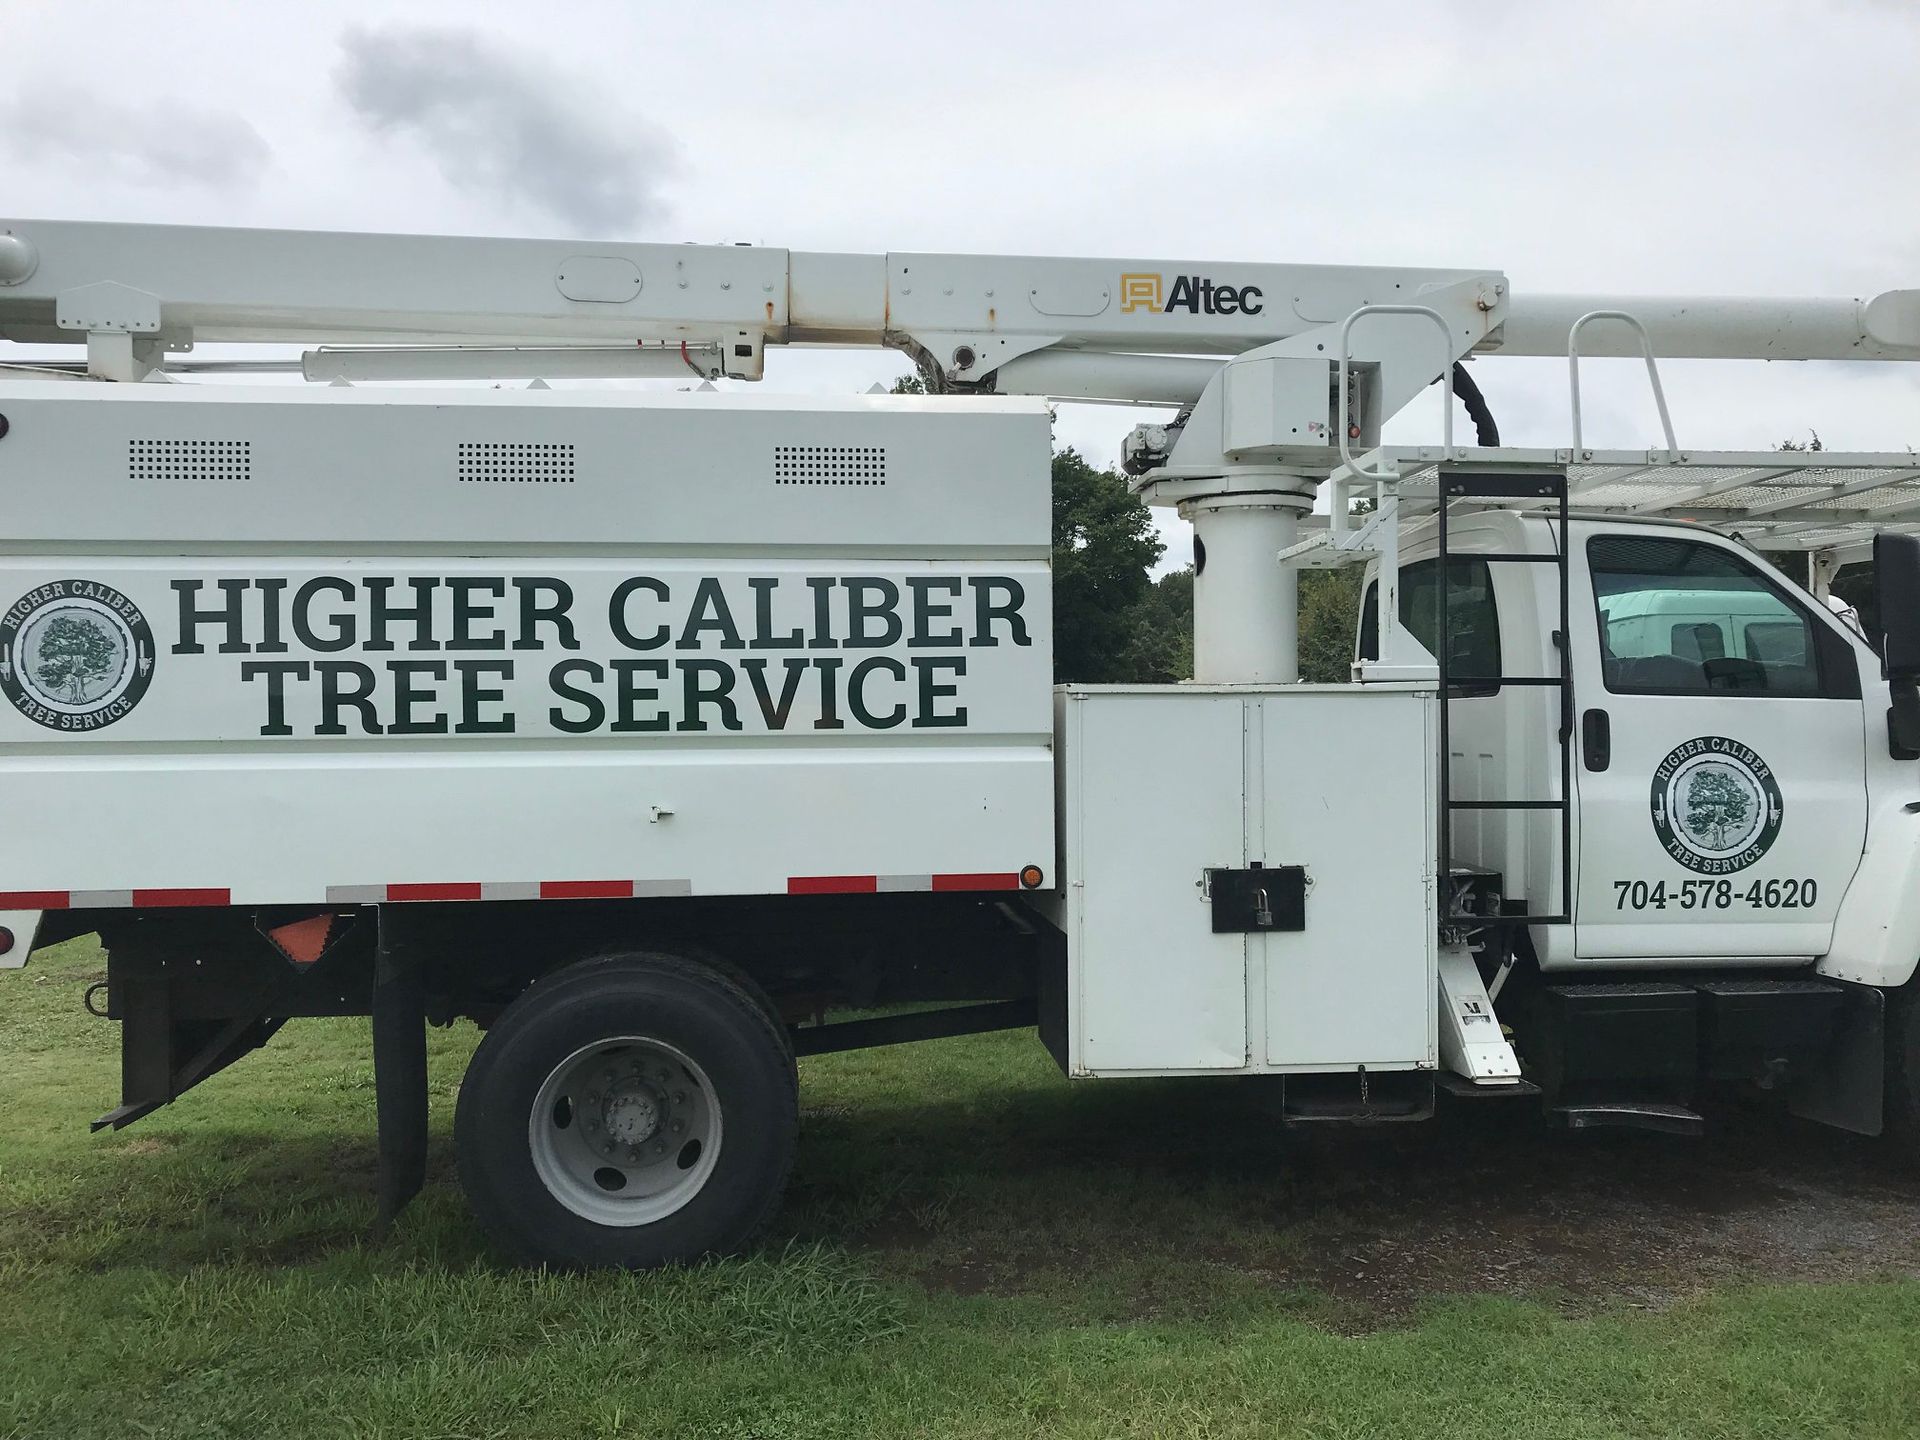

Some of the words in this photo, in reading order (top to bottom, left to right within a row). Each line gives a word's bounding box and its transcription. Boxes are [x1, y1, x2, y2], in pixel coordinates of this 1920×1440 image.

[1164, 275, 1263, 315] Altec
[3, 583, 66, 631] HIGHER
[71, 581, 142, 627] CALIBER
[170, 576, 581, 654] HIGHER
[608, 576, 1032, 651] CALIBER
[15, 692, 58, 726] TREE
[61, 695, 132, 729] SERVICE
[241, 659, 516, 736] TREE
[548, 655, 968, 734] SERVICE
[1656, 739, 1706, 782] HIGHER
[1710, 737, 1770, 780] CALIBER
[1667, 837, 1701, 869] TREE
[1703, 843, 1763, 873] SERVICE
[1613, 878, 1818, 910] 704-578-4620
